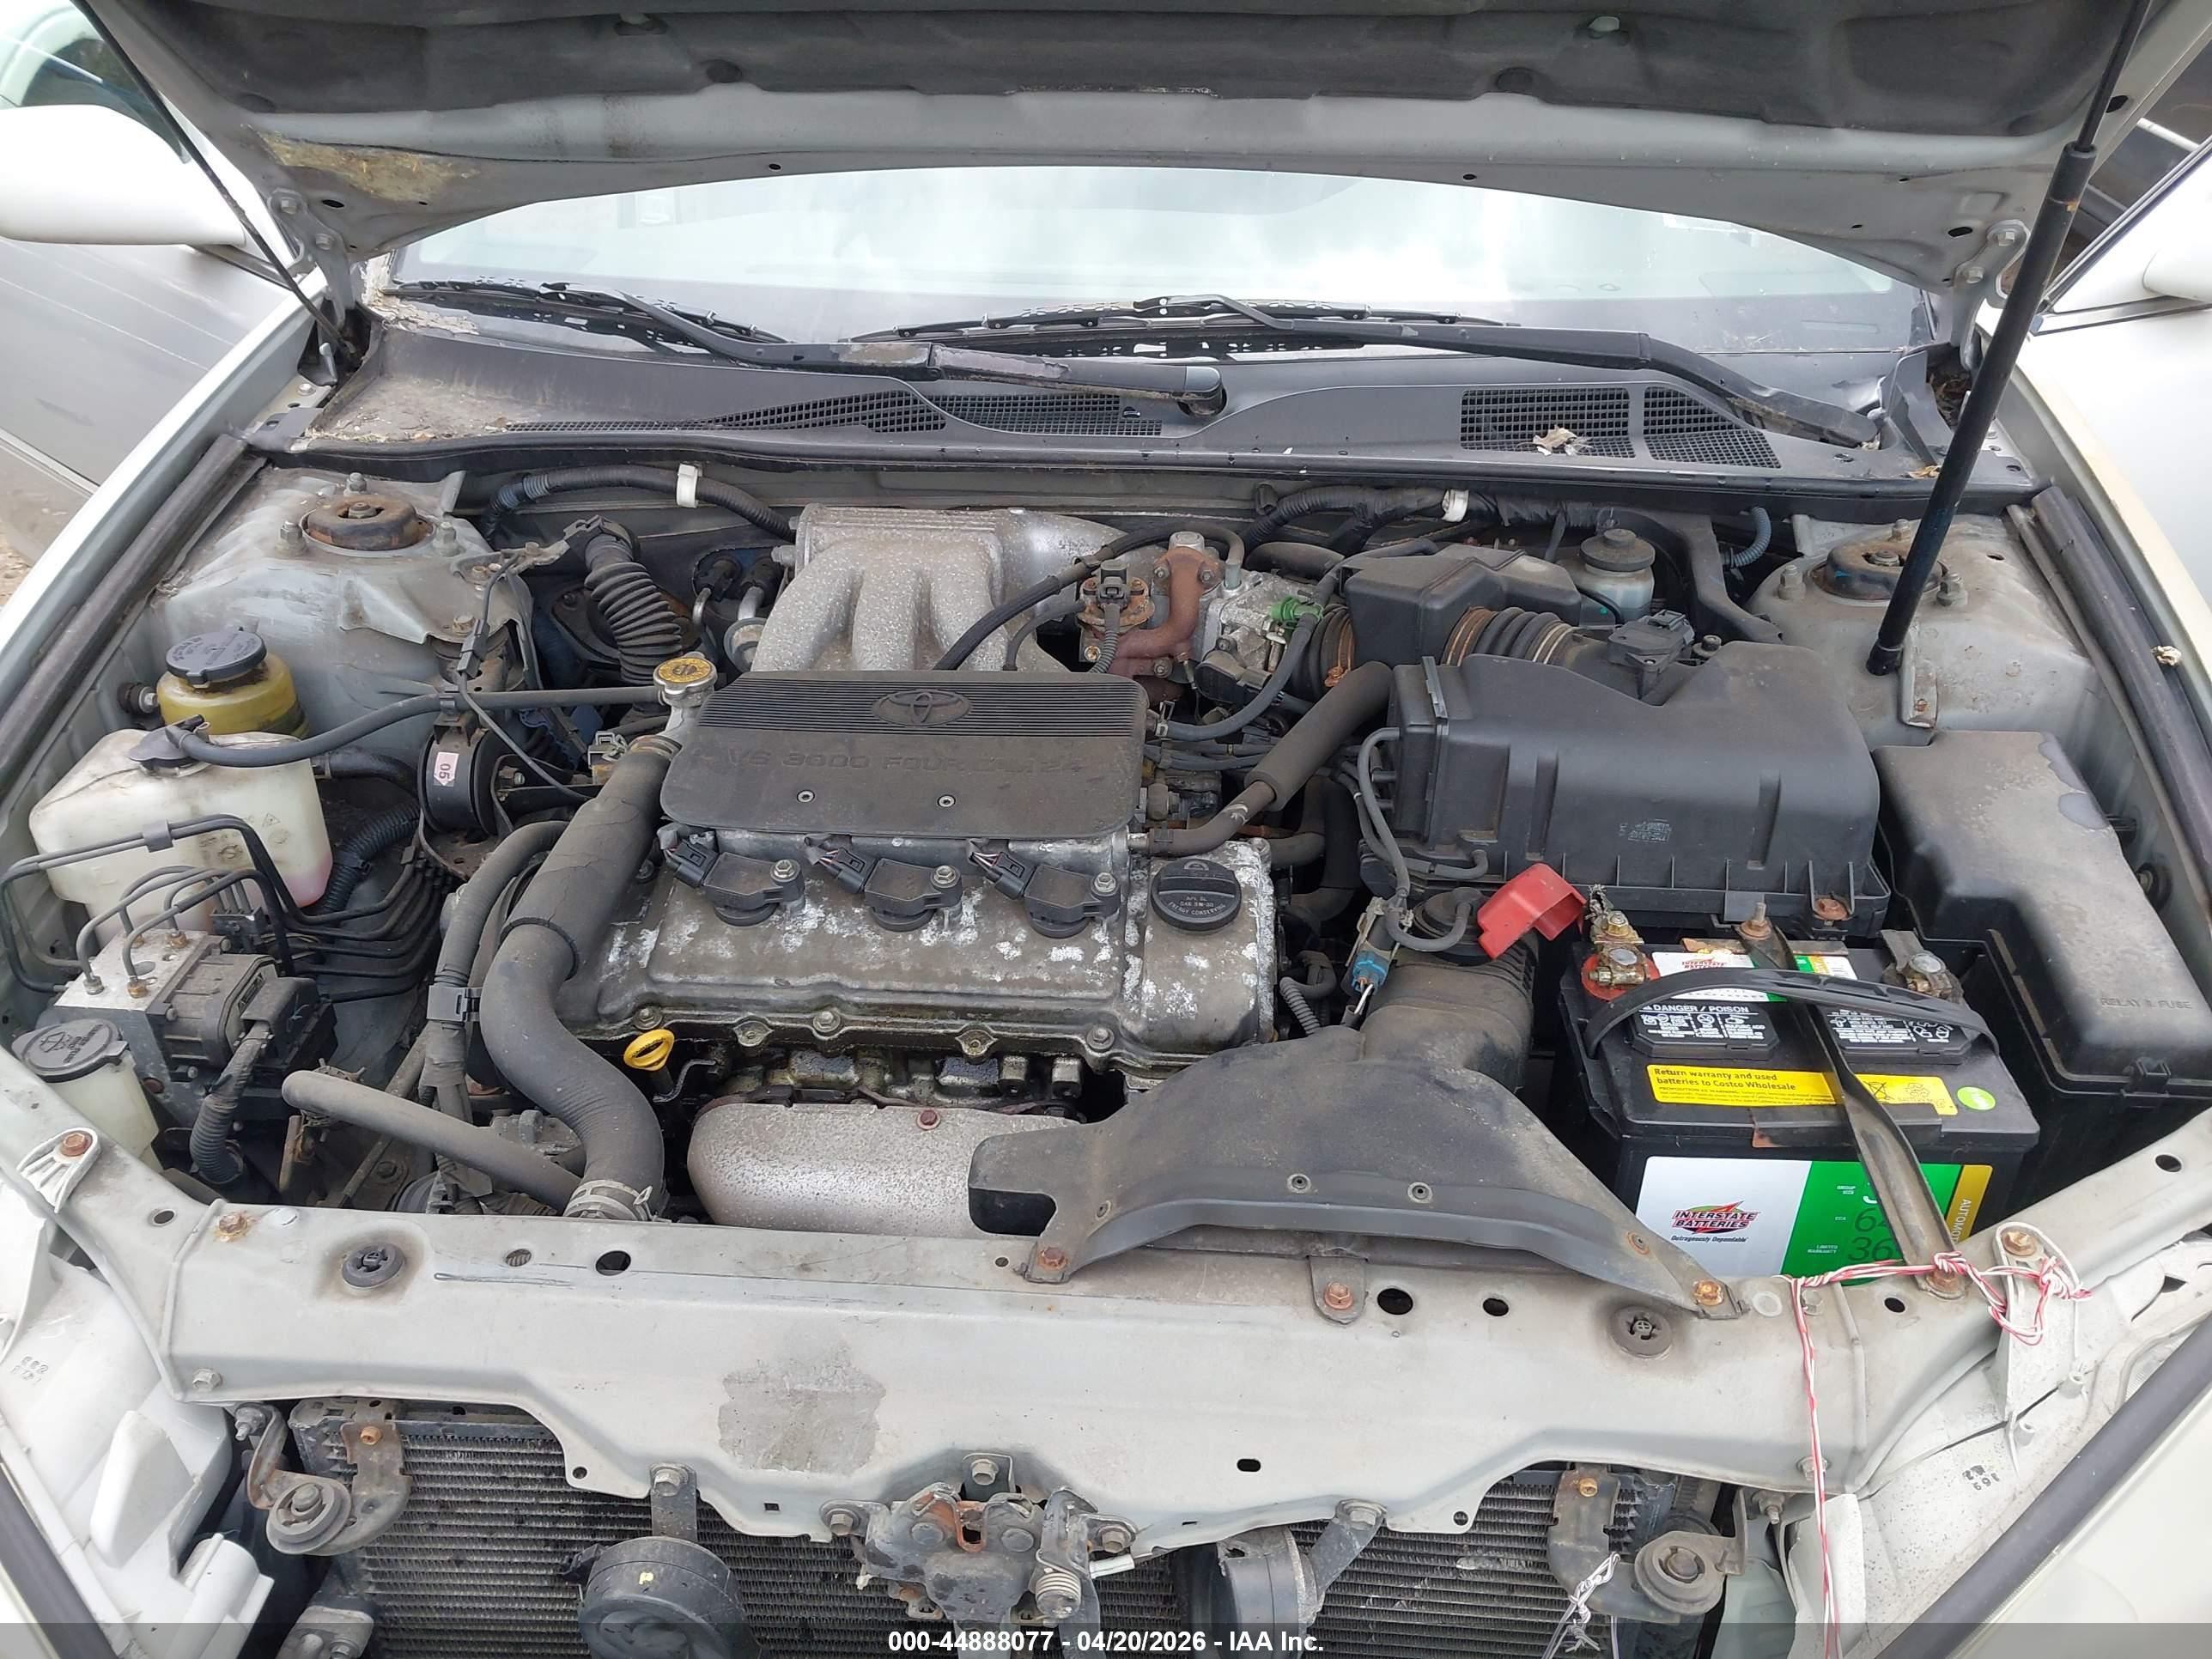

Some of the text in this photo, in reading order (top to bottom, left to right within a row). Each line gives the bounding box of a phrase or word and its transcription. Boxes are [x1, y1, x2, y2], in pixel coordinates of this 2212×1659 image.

[781, 751, 870, 769] 3000
[1653, 1004, 1698, 1012] DANGER
[2158, 1000, 2193, 1009] FUSE
[1689, 1071, 1731, 1080] warranty
[1747, 1081, 1796, 1091] Wholesale
[1674, 1212, 1756, 1220] INTERSTATE
[1675, 1219, 1747, 1228] BATTERIES
